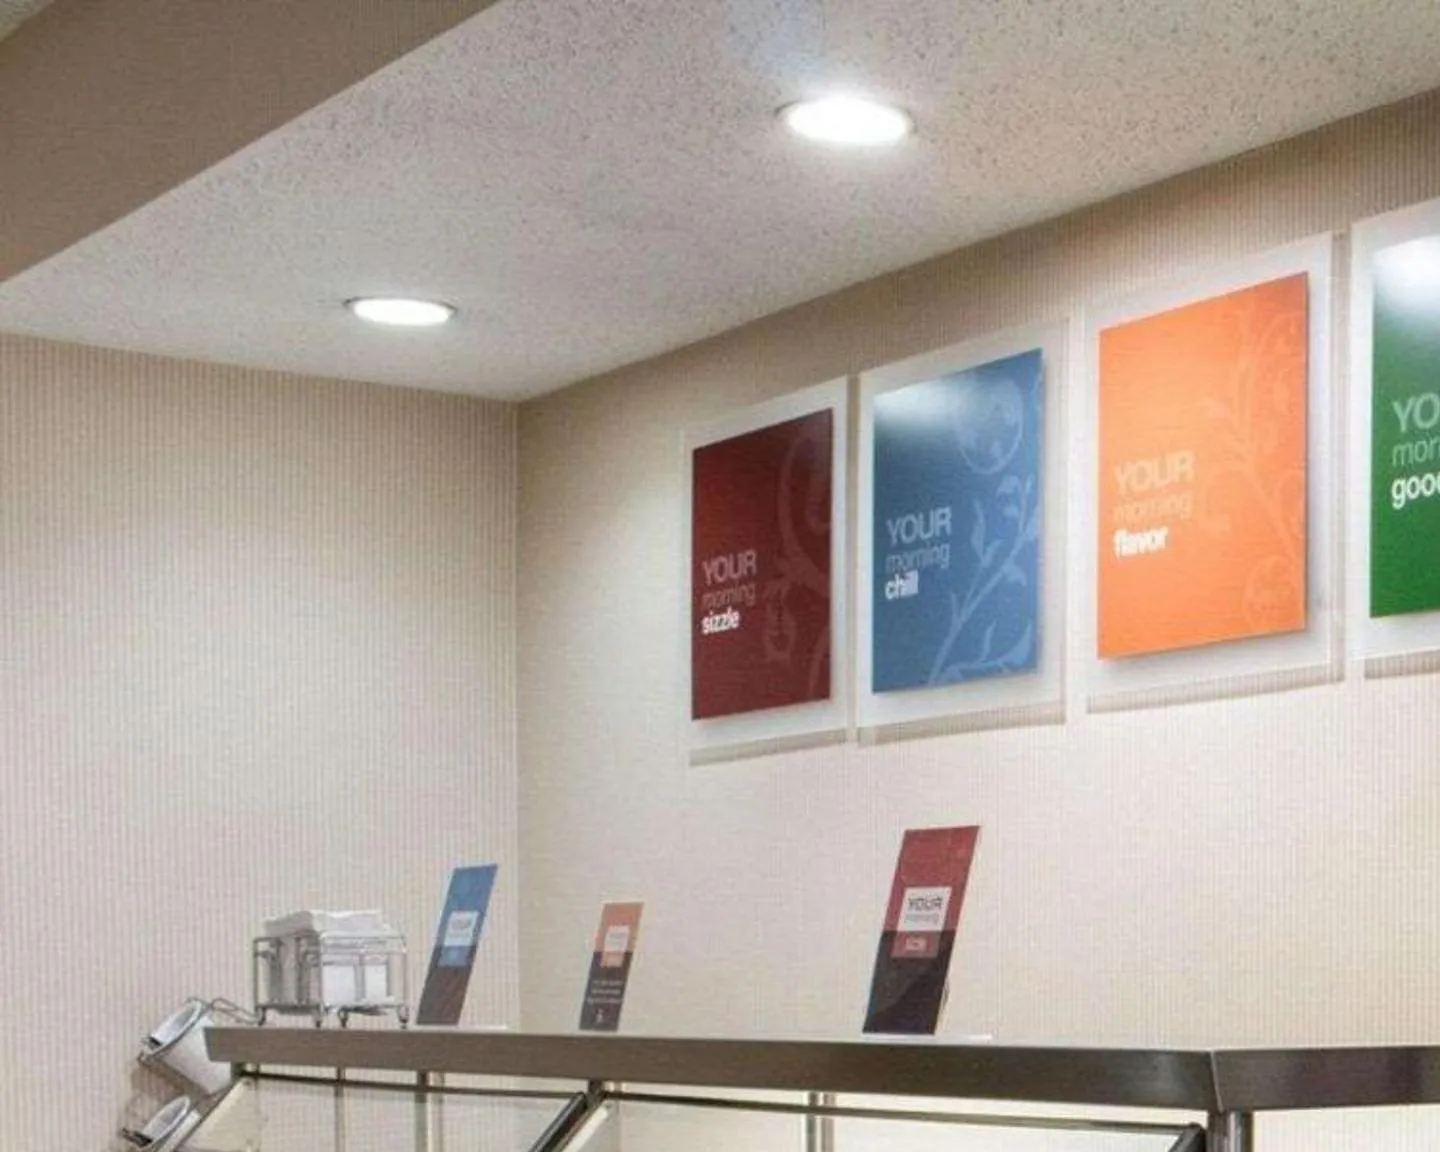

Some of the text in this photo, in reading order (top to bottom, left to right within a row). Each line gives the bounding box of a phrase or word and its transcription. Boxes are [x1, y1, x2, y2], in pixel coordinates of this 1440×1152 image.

[1113, 450, 1194, 498] YOUR
[886, 506, 952, 548] YOUR
[1113, 527, 1168, 559] flavor
[702, 549, 757, 586] YOUR
[884, 570, 919, 600] chill
[702, 606, 740, 630] sizzle
